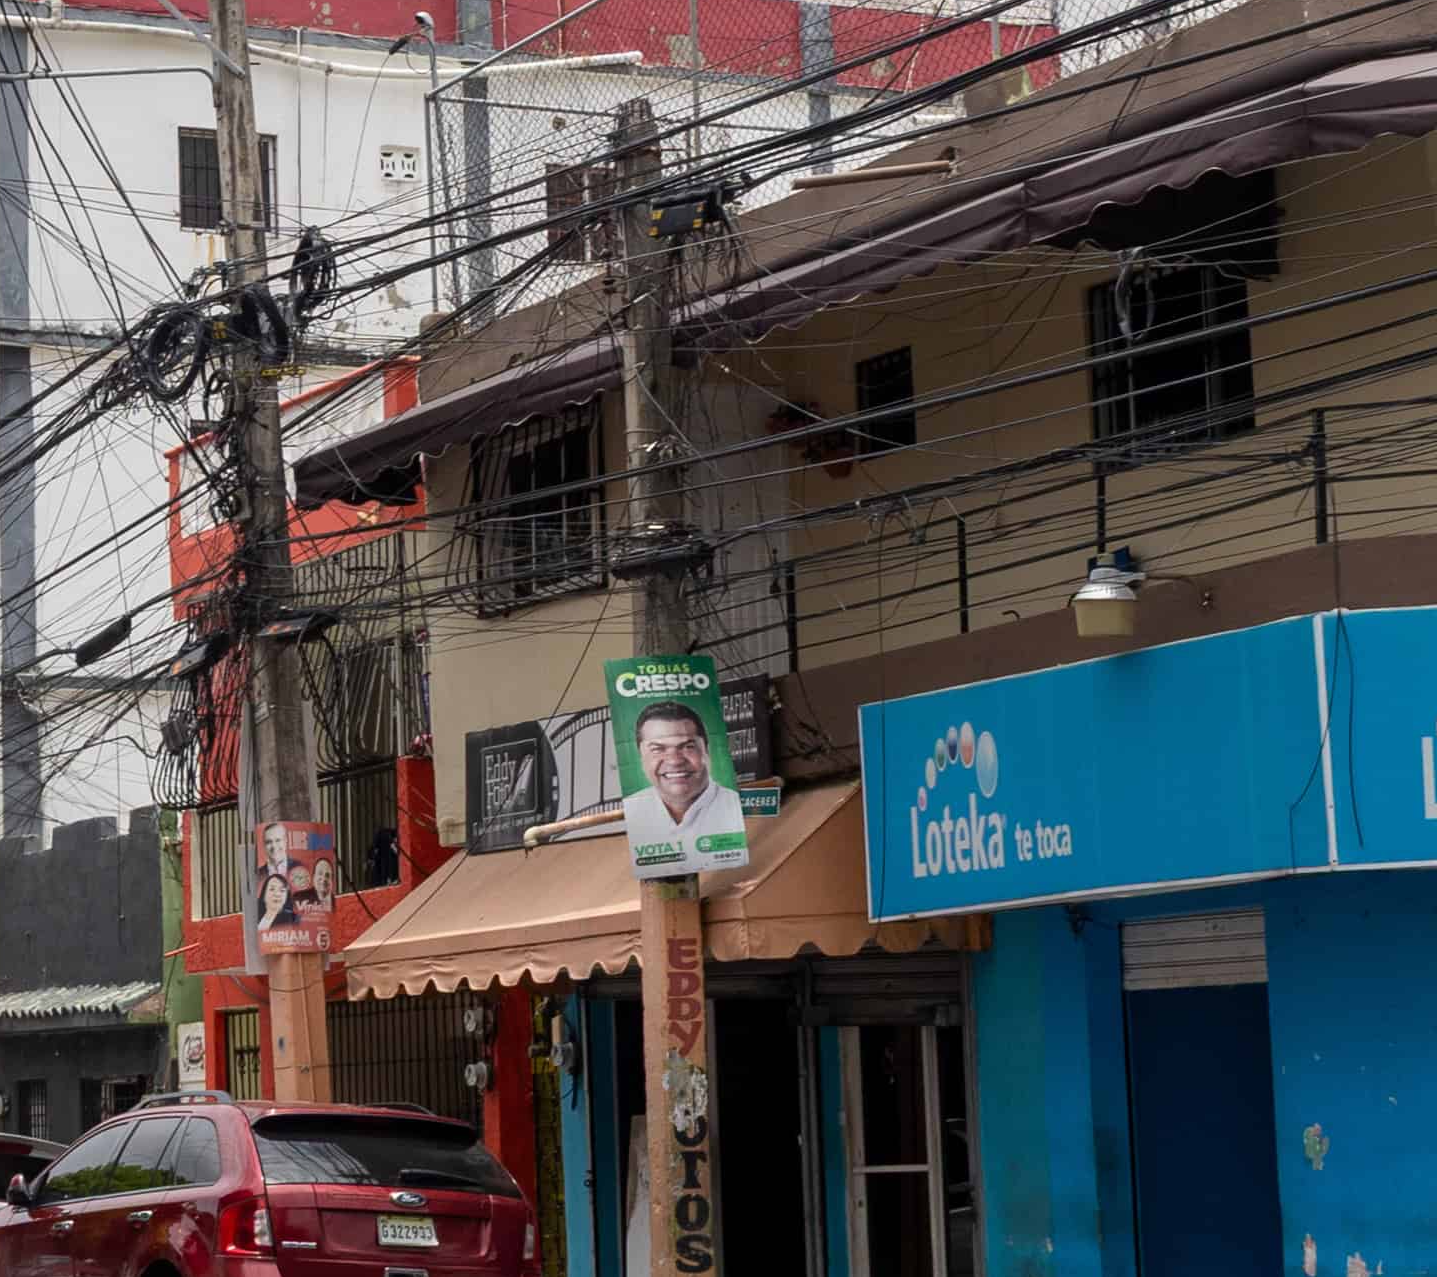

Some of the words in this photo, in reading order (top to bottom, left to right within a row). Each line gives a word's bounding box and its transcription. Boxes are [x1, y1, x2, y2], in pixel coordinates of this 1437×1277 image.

[615, 672, 710, 697] CRESPO
[485, 752, 517, 792] Eddy
[635, 842, 674, 856] VOTA
[676, 841, 683, 851] 1
[911, 793, 1005, 878] Loteka
[1015, 822, 1033, 861] te
[1036, 820, 1072, 858] toca
[261, 930, 309, 942] MIRIAM
[667, 938, 702, 1057] EDDY
